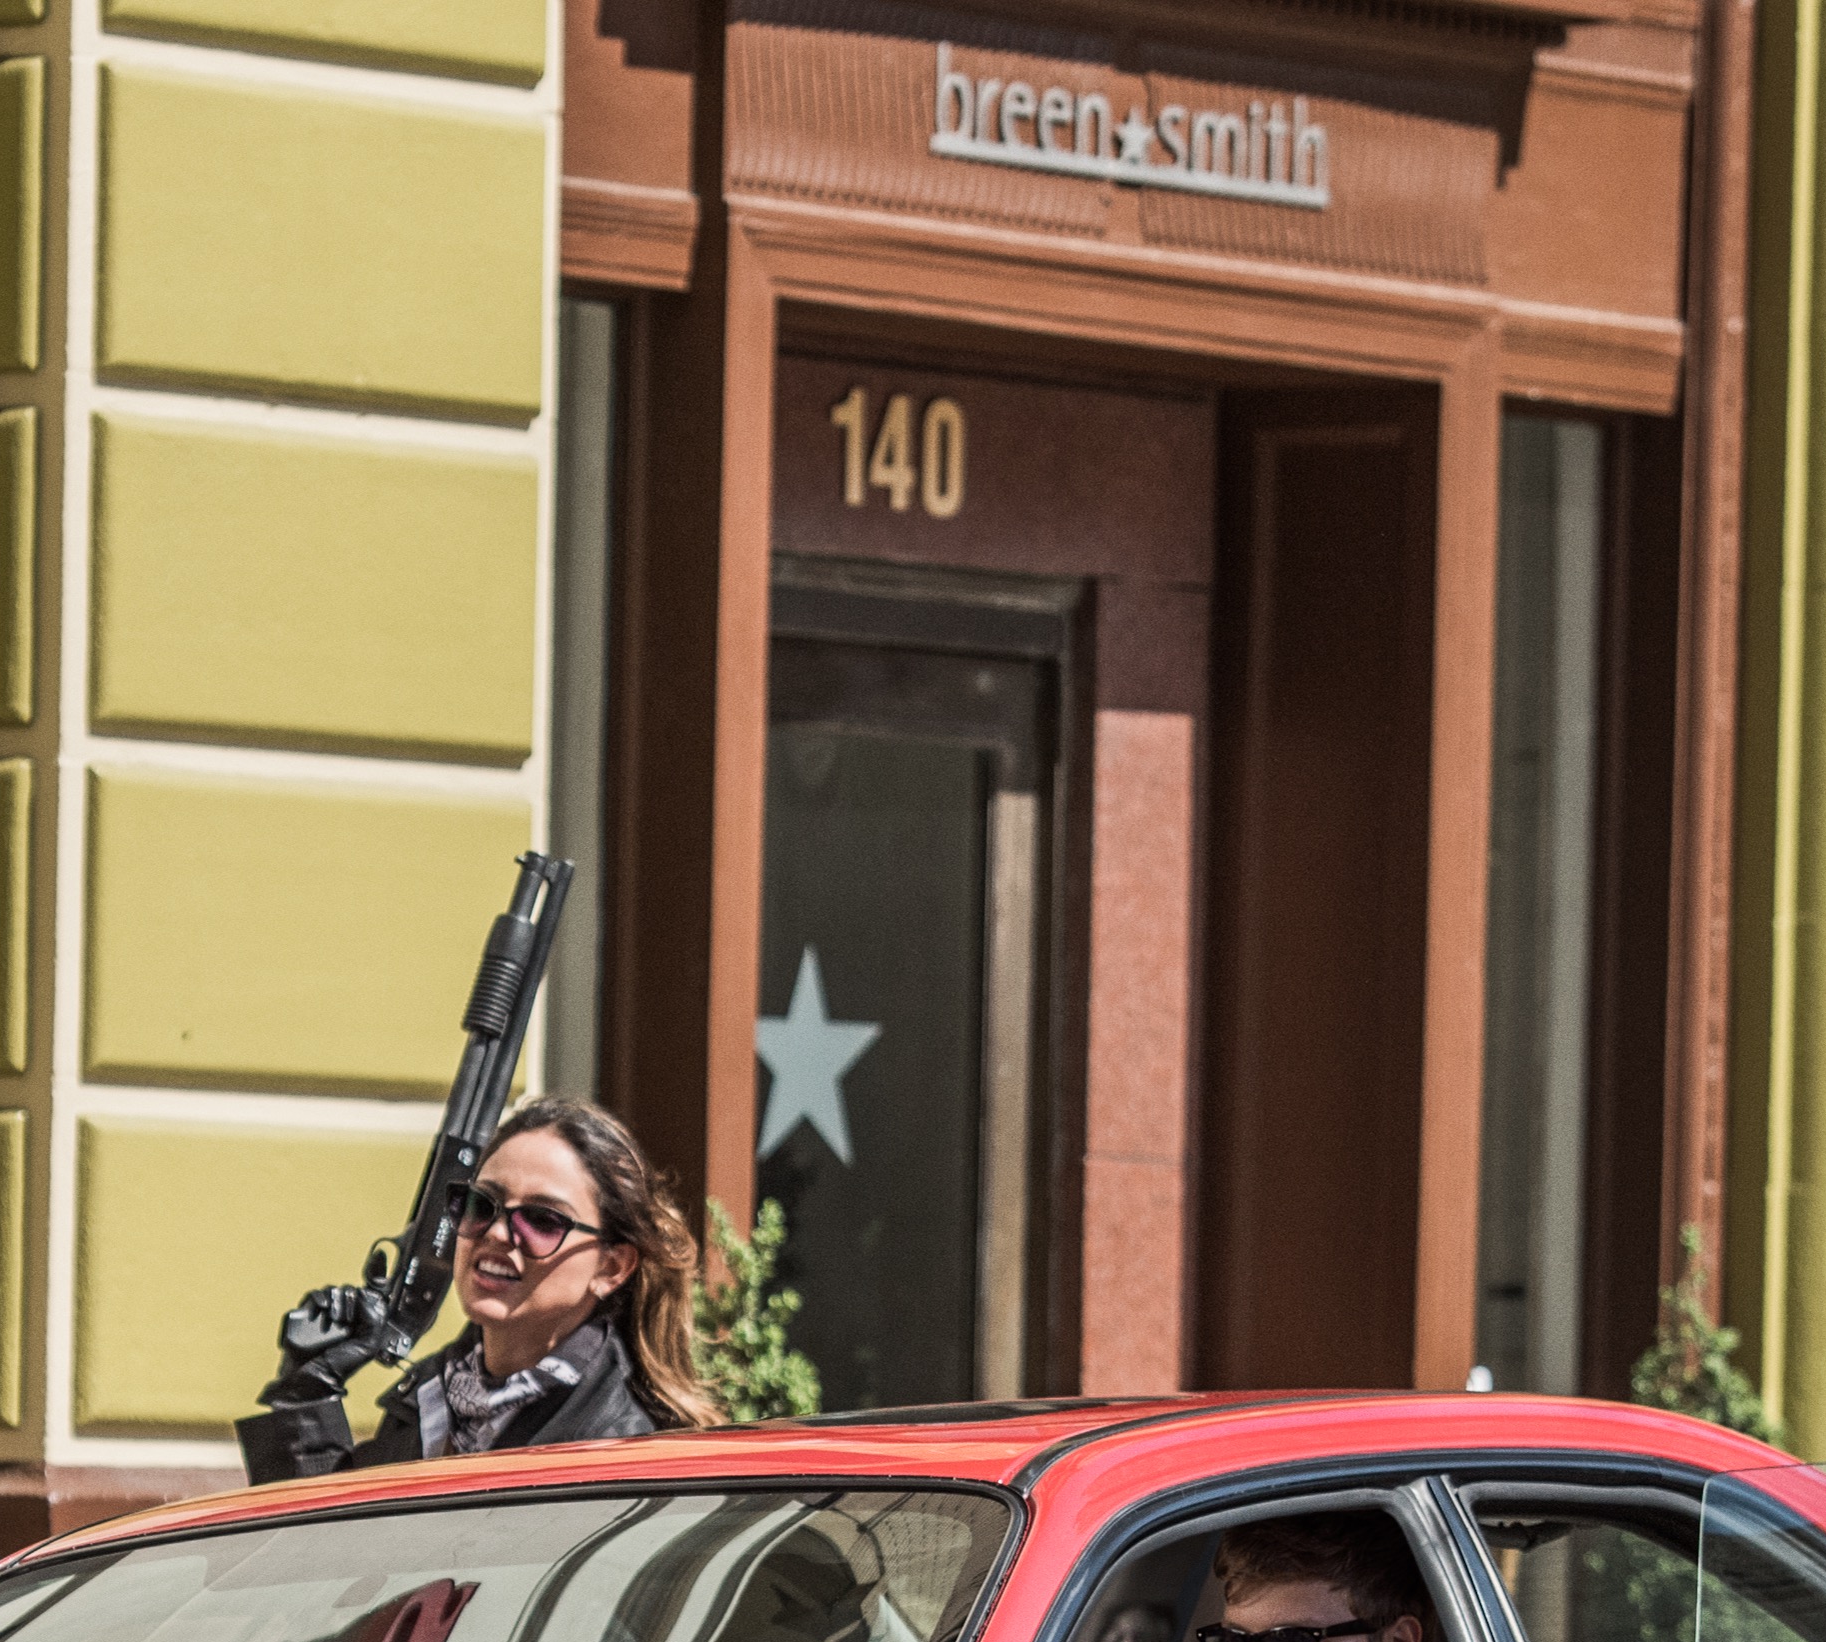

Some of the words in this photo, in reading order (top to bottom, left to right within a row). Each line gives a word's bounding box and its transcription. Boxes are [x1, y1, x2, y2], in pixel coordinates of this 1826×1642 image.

[935, 40, 1113, 160] breen
[1157, 95, 1330, 190] smith
[830, 387, 966, 519] 140
